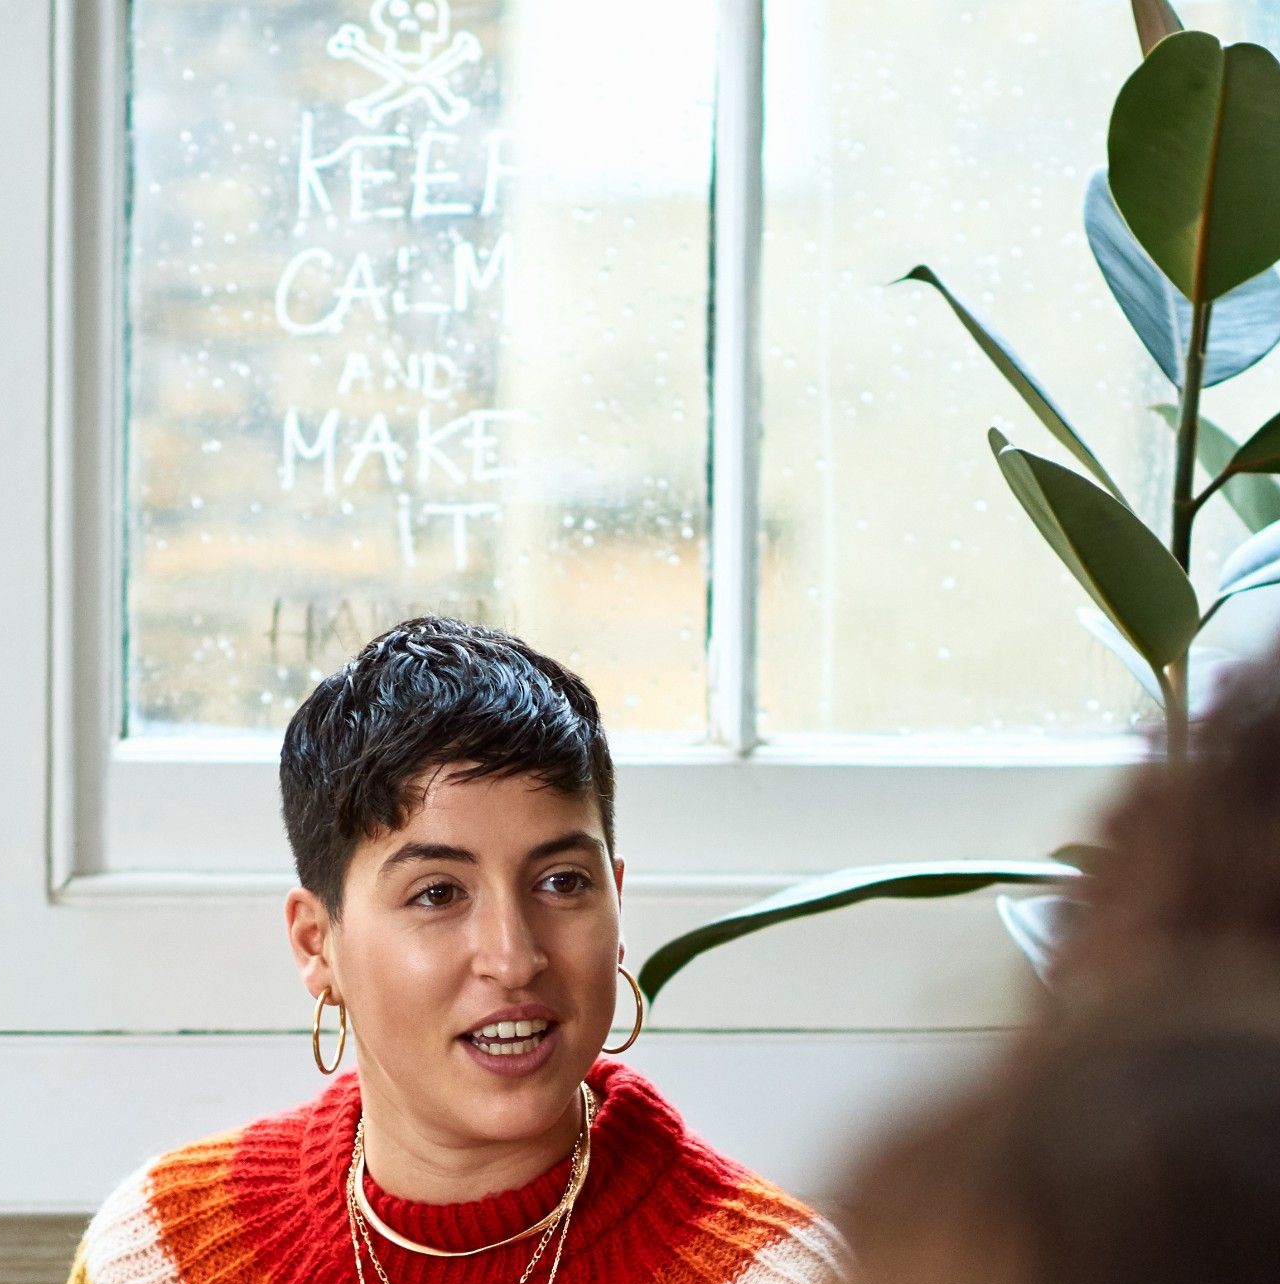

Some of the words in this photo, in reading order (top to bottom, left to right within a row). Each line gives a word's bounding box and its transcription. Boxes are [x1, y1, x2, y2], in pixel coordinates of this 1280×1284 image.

[275, 231, 514, 335] CALM
[336, 351, 458, 399] AND
[280, 406, 532, 496] MAKE
[397, 493, 499, 571] IT
